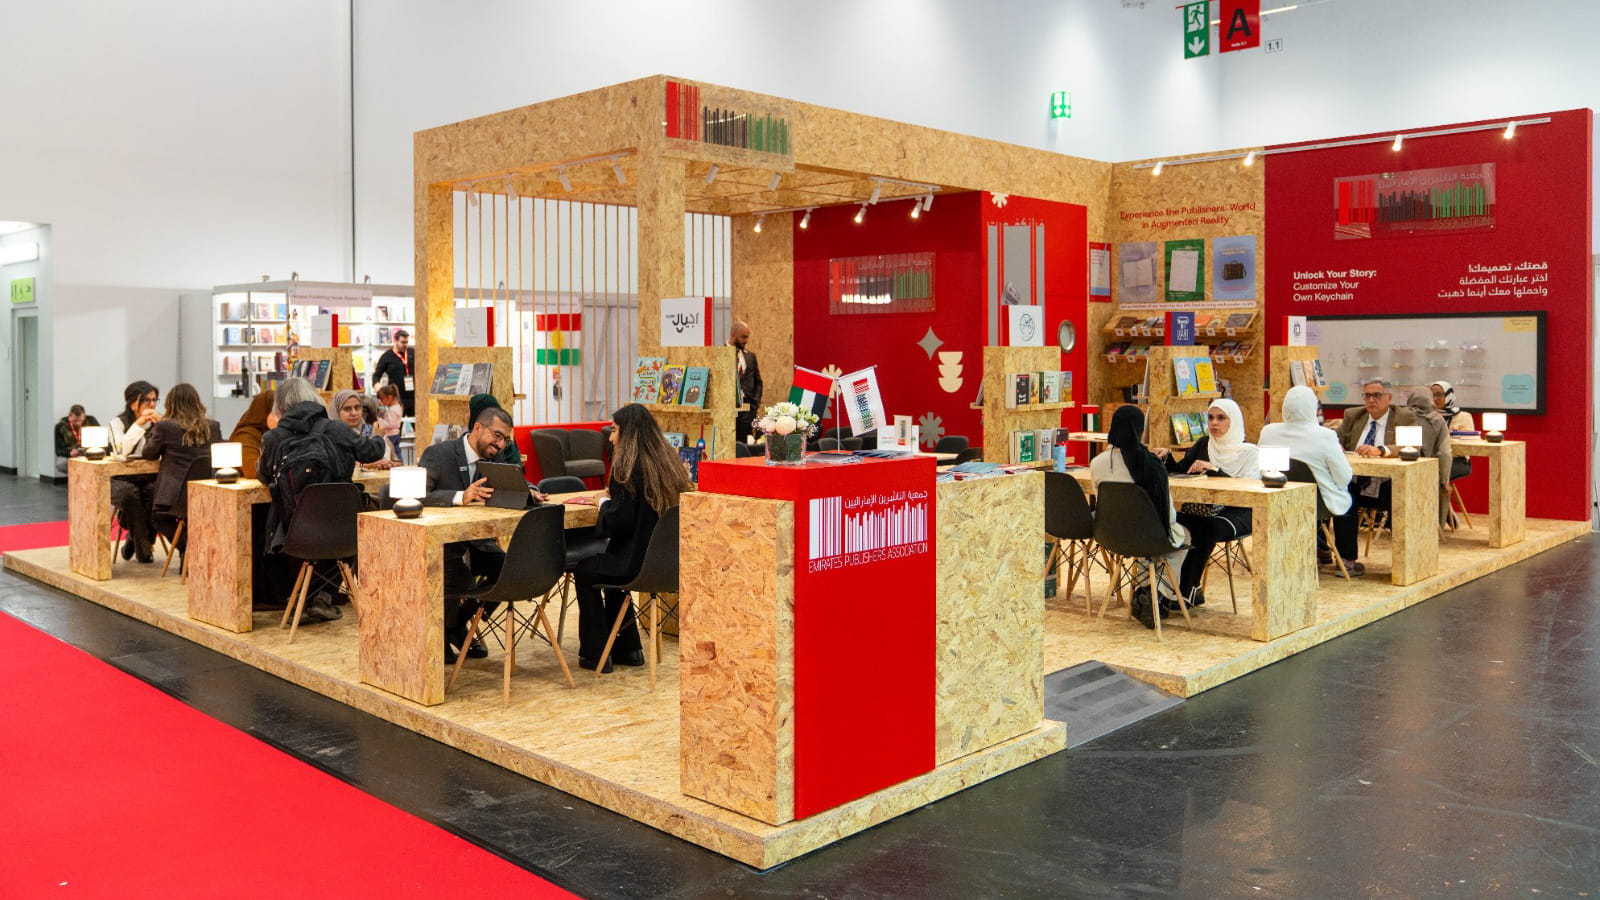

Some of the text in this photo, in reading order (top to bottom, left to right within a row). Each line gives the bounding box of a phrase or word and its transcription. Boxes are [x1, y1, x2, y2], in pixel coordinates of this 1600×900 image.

[1226, 8, 1252, 40] A
[1267, 40, 1281, 51] 1.1
[1120, 210, 1164, 220] Experience
[1166, 207, 1179, 216] the
[1229, 202, 1256, 212] World
[1151, 217, 1198, 229] Augmented
[1200, 215, 1229, 226] Reality
[1293, 269, 1377, 280] Unlock Your Story:
[1469, 263, 1512, 274] تصميمك!
[1459, 272, 1548, 285] اختر عبارتك المفضلة
[1293, 281, 1360, 290] Customize Your
[1437, 285, 1548, 299] واحملها معك أينما ذهبت
[1293, 292, 1354, 302] Own Keychain
[844, 490, 928, 509] جمعية الناشرين الإماراتيين
[808, 542, 928, 574] EMIRATES PUBLISHERS ASSOCIATION
